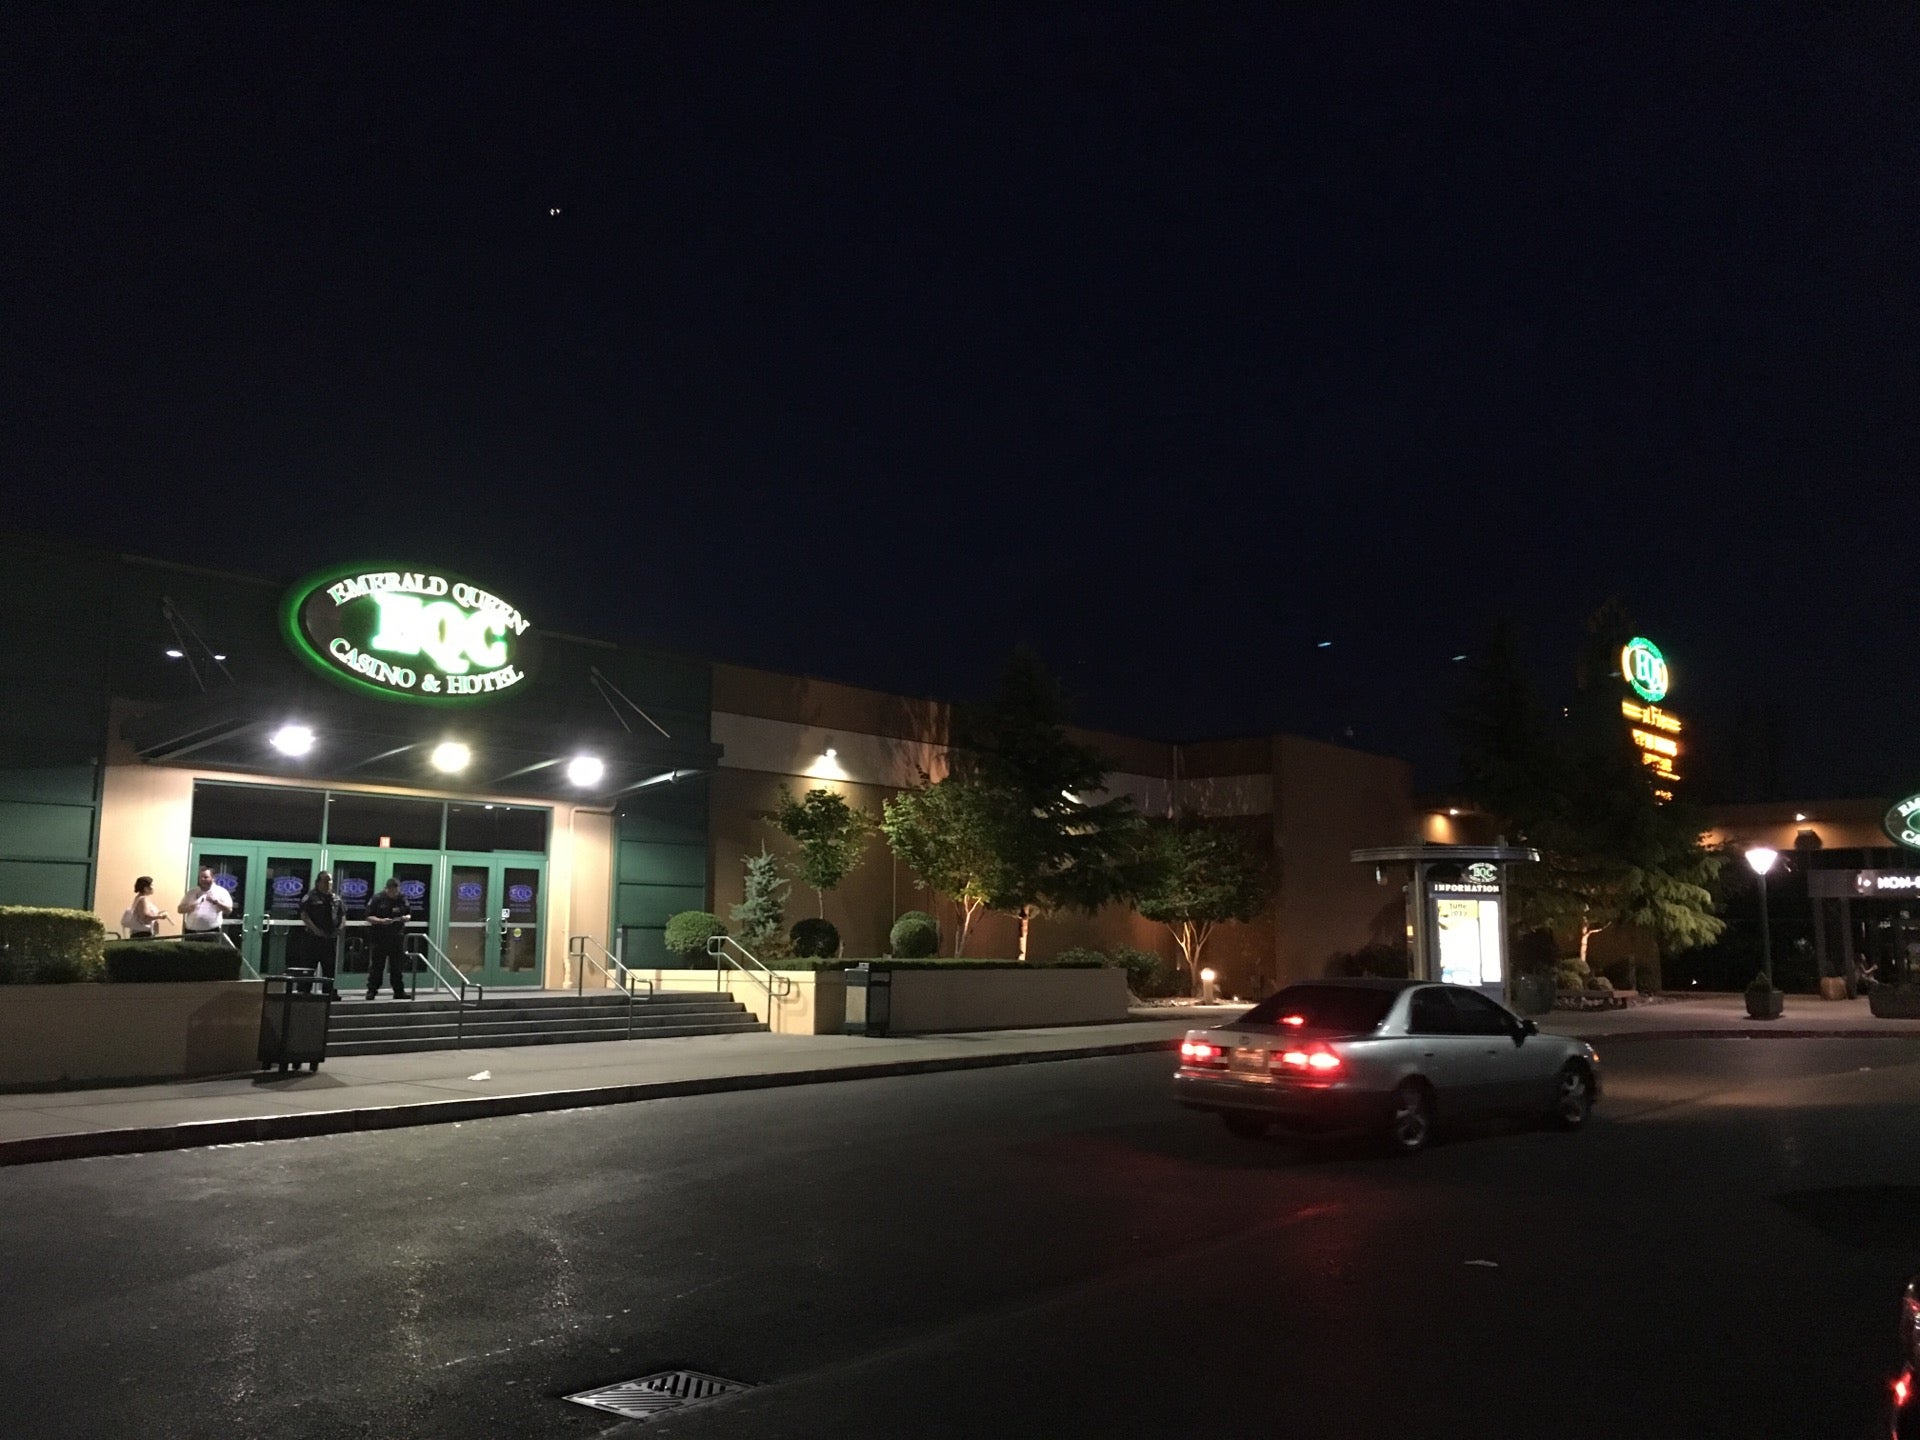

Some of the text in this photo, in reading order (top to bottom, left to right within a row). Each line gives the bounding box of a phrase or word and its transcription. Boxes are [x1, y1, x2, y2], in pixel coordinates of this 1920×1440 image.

[327, 572, 530, 636] EMERALD QUEEN
[329, 638, 525, 694] CASINO & HOTEL
[1434, 884, 1500, 892] INFORMATION
